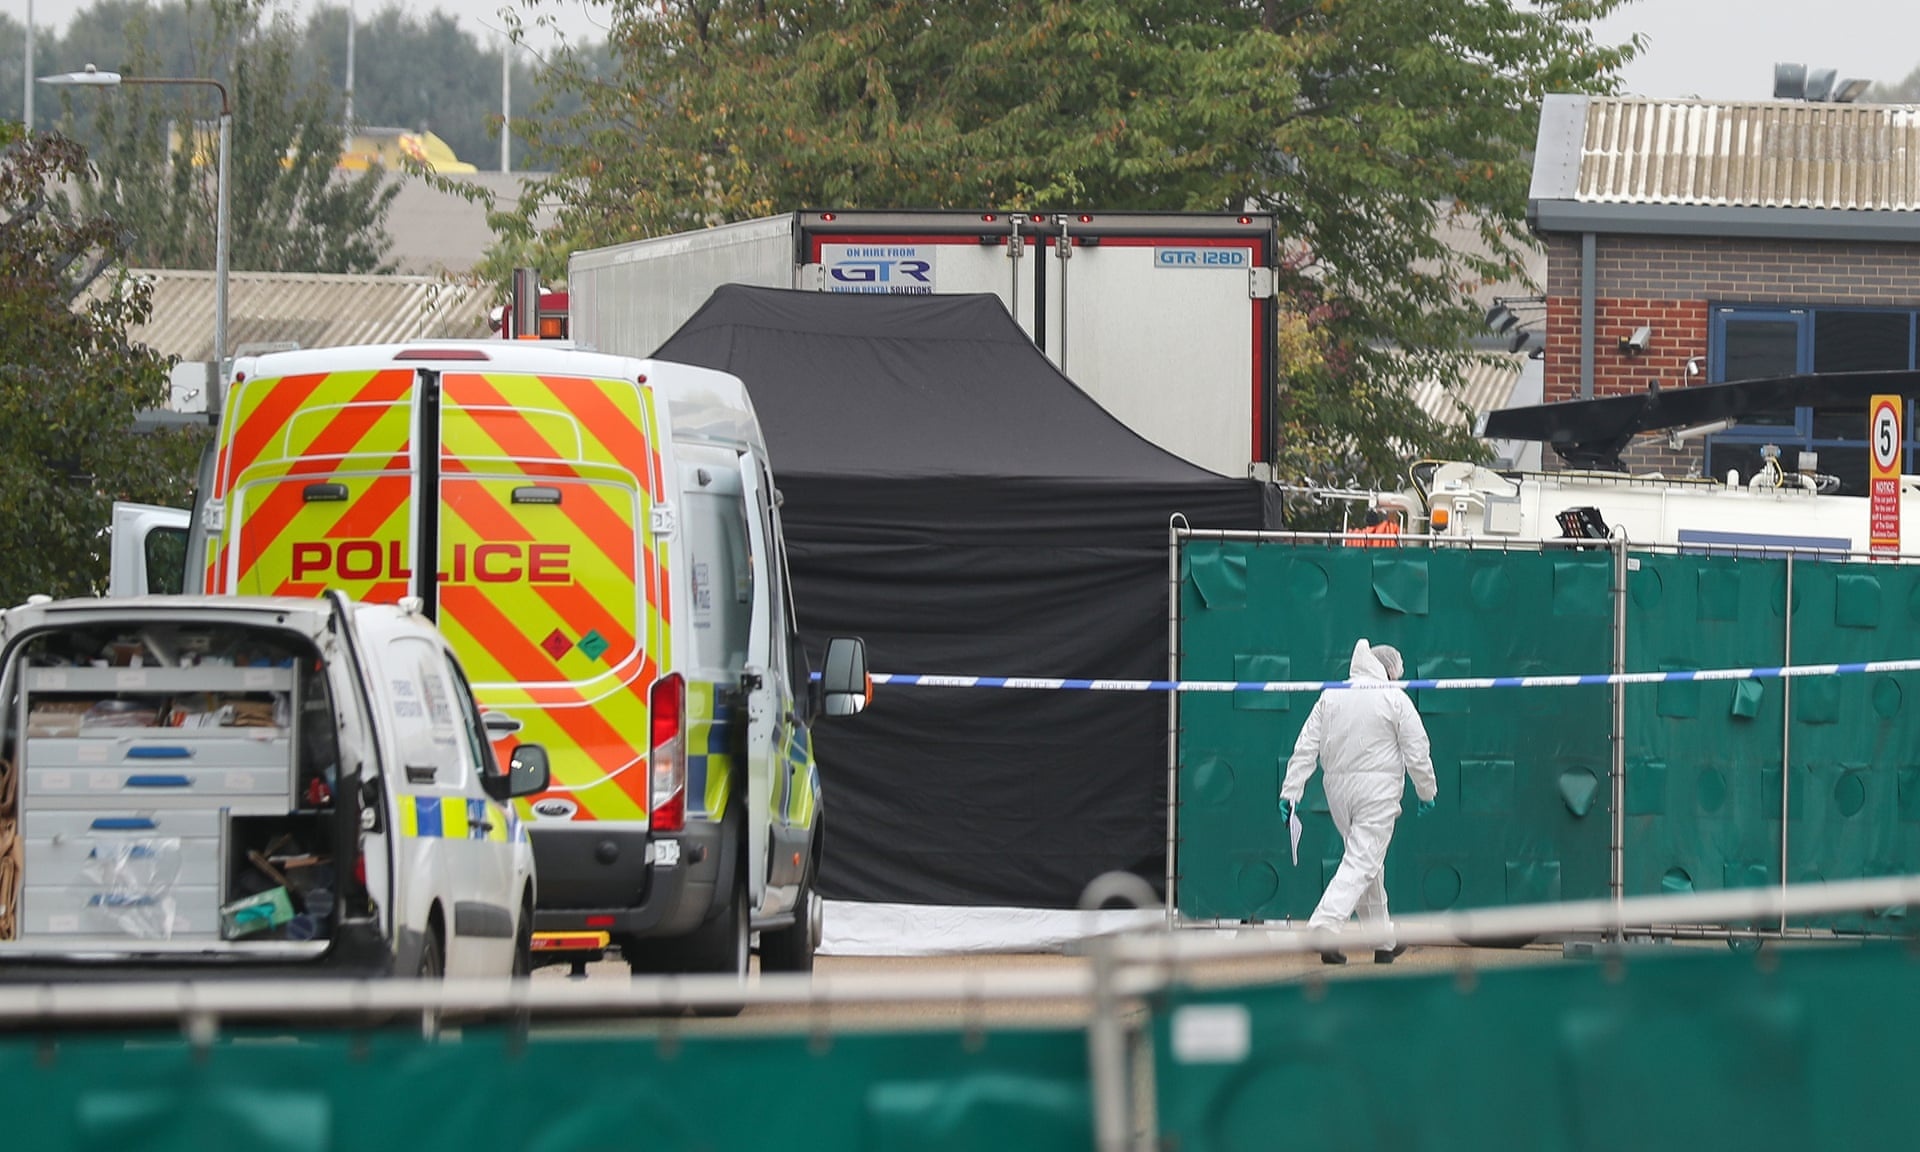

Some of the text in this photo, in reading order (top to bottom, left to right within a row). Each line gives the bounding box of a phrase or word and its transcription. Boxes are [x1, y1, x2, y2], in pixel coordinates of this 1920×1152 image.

[846, 247, 916, 257] ON HIRE FROM
[1160, 250, 1243, 265] GTR 128D
[830, 260, 931, 282] GTR
[890, 286, 932, 294] SOLUTIONS
[1880, 420, 1891, 457] 5
[1875, 481, 1895, 494] NOTICE
[291, 540, 571, 583] POLICE
[927, 679, 962, 687] POLICE
[1014, 681, 1050, 689] POLICE
